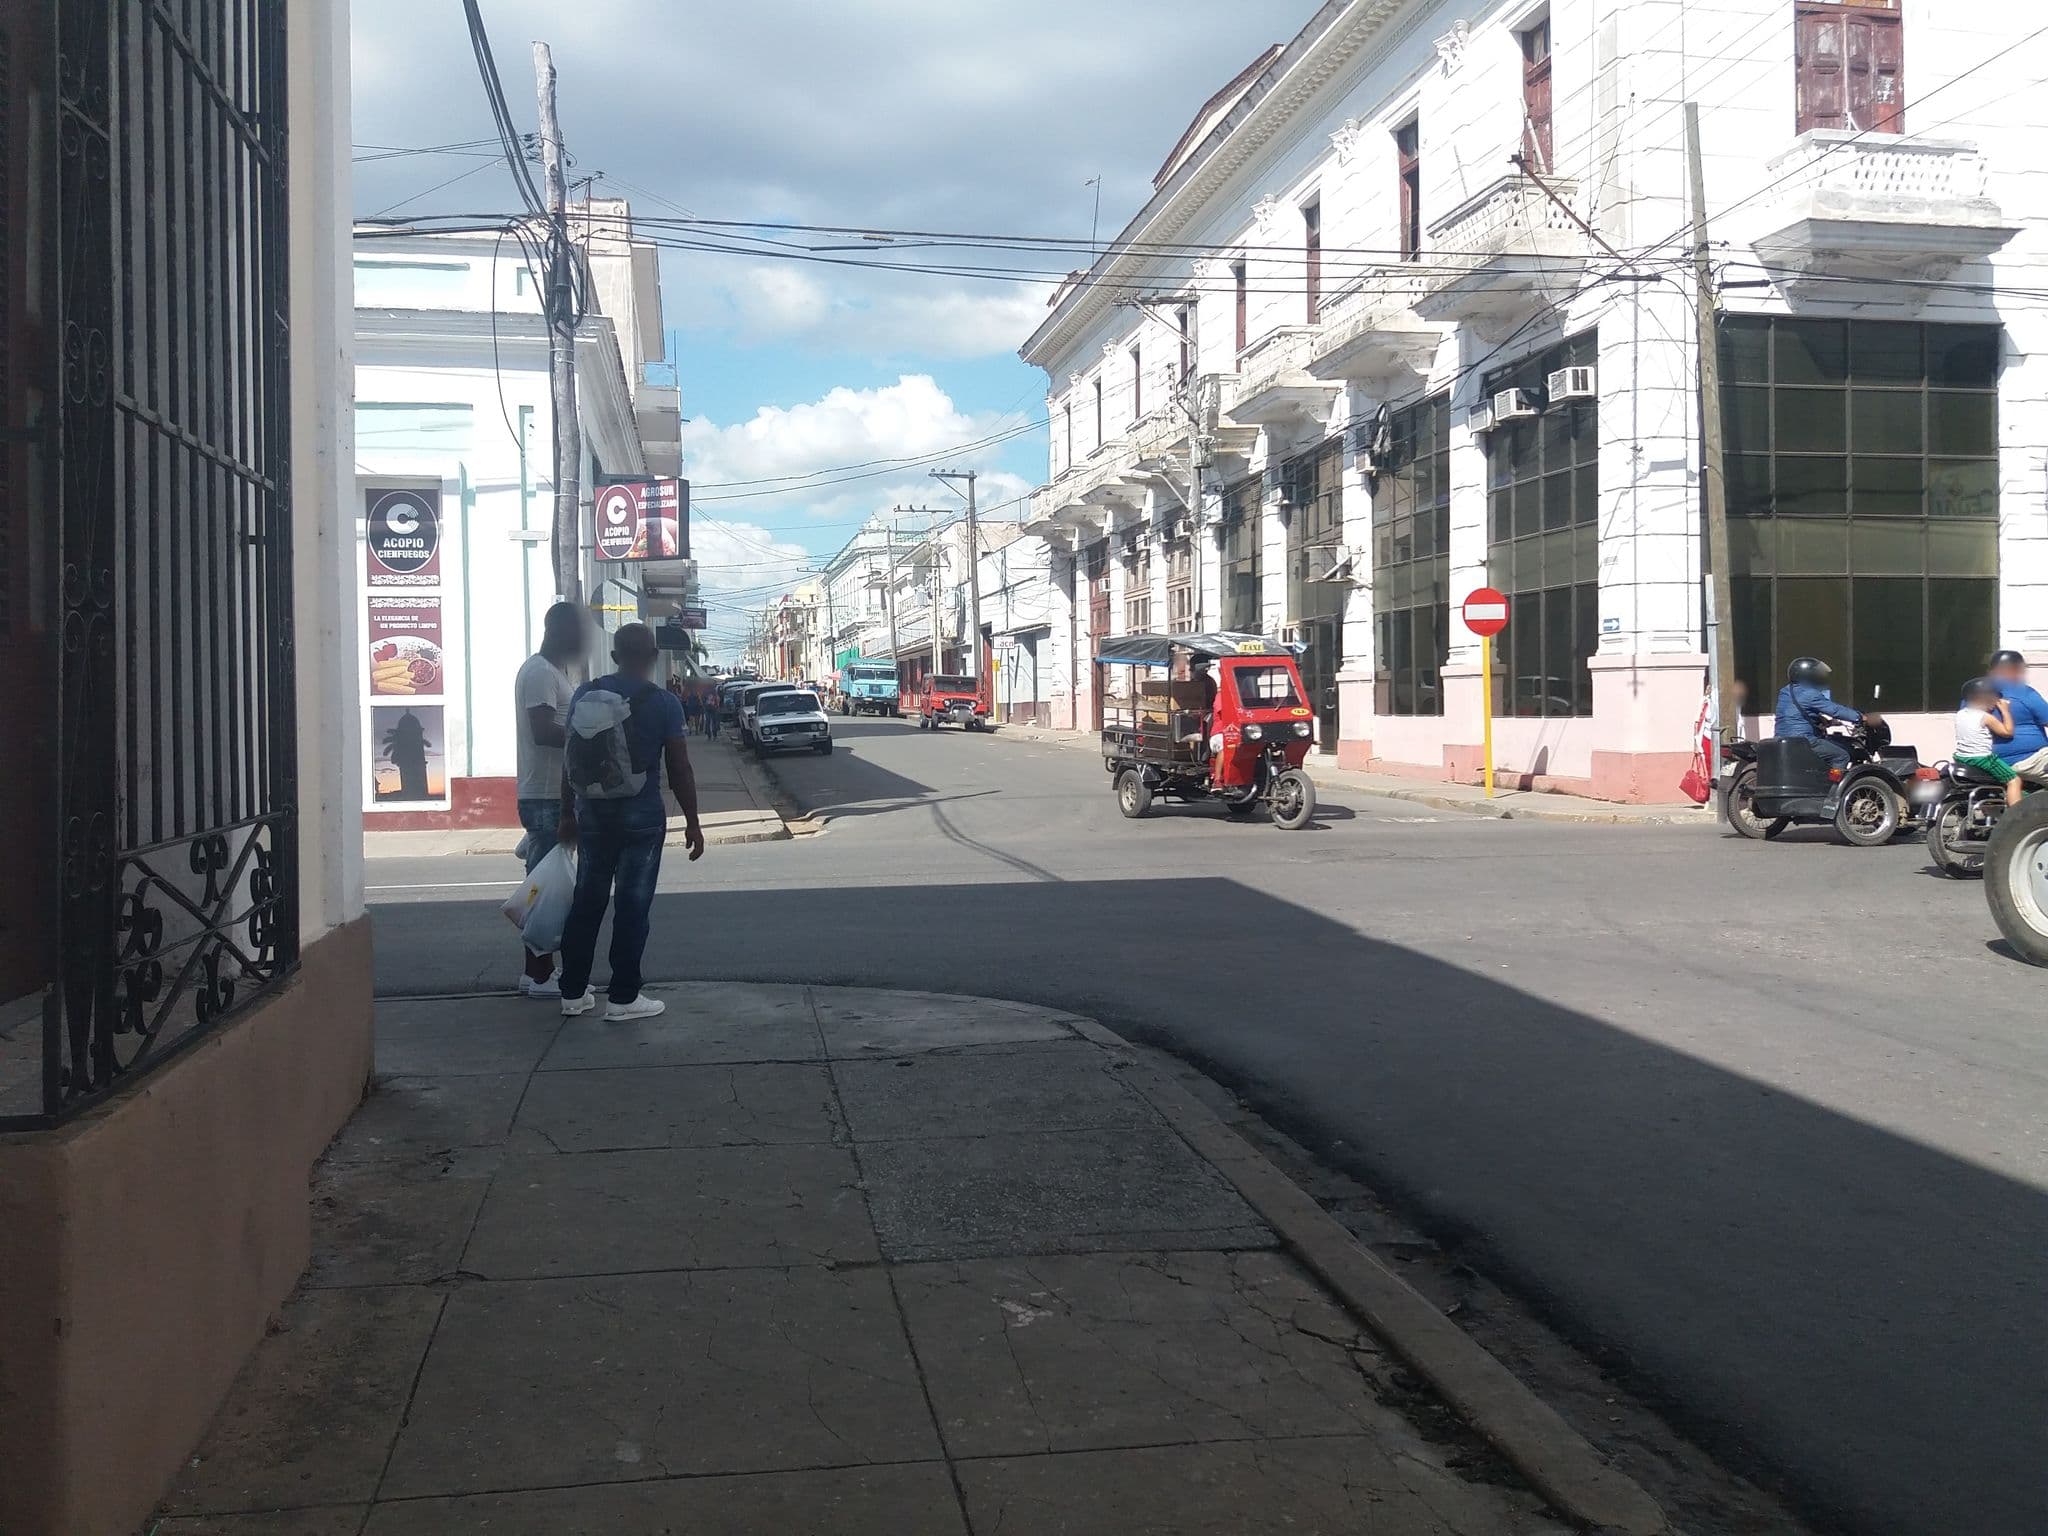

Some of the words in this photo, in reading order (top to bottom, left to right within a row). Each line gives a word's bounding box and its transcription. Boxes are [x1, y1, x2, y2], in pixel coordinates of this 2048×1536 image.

[640, 485, 674, 498] AGROSUR
[637, 499, 677, 509] ESPECIALIZADO
[604, 526, 630, 537] ACOPIO
[383, 537, 424, 548] ACOPIO
[601, 537, 633, 547] CIENFUEGOS
[377, 550, 430, 559] CIENFUEGOS
